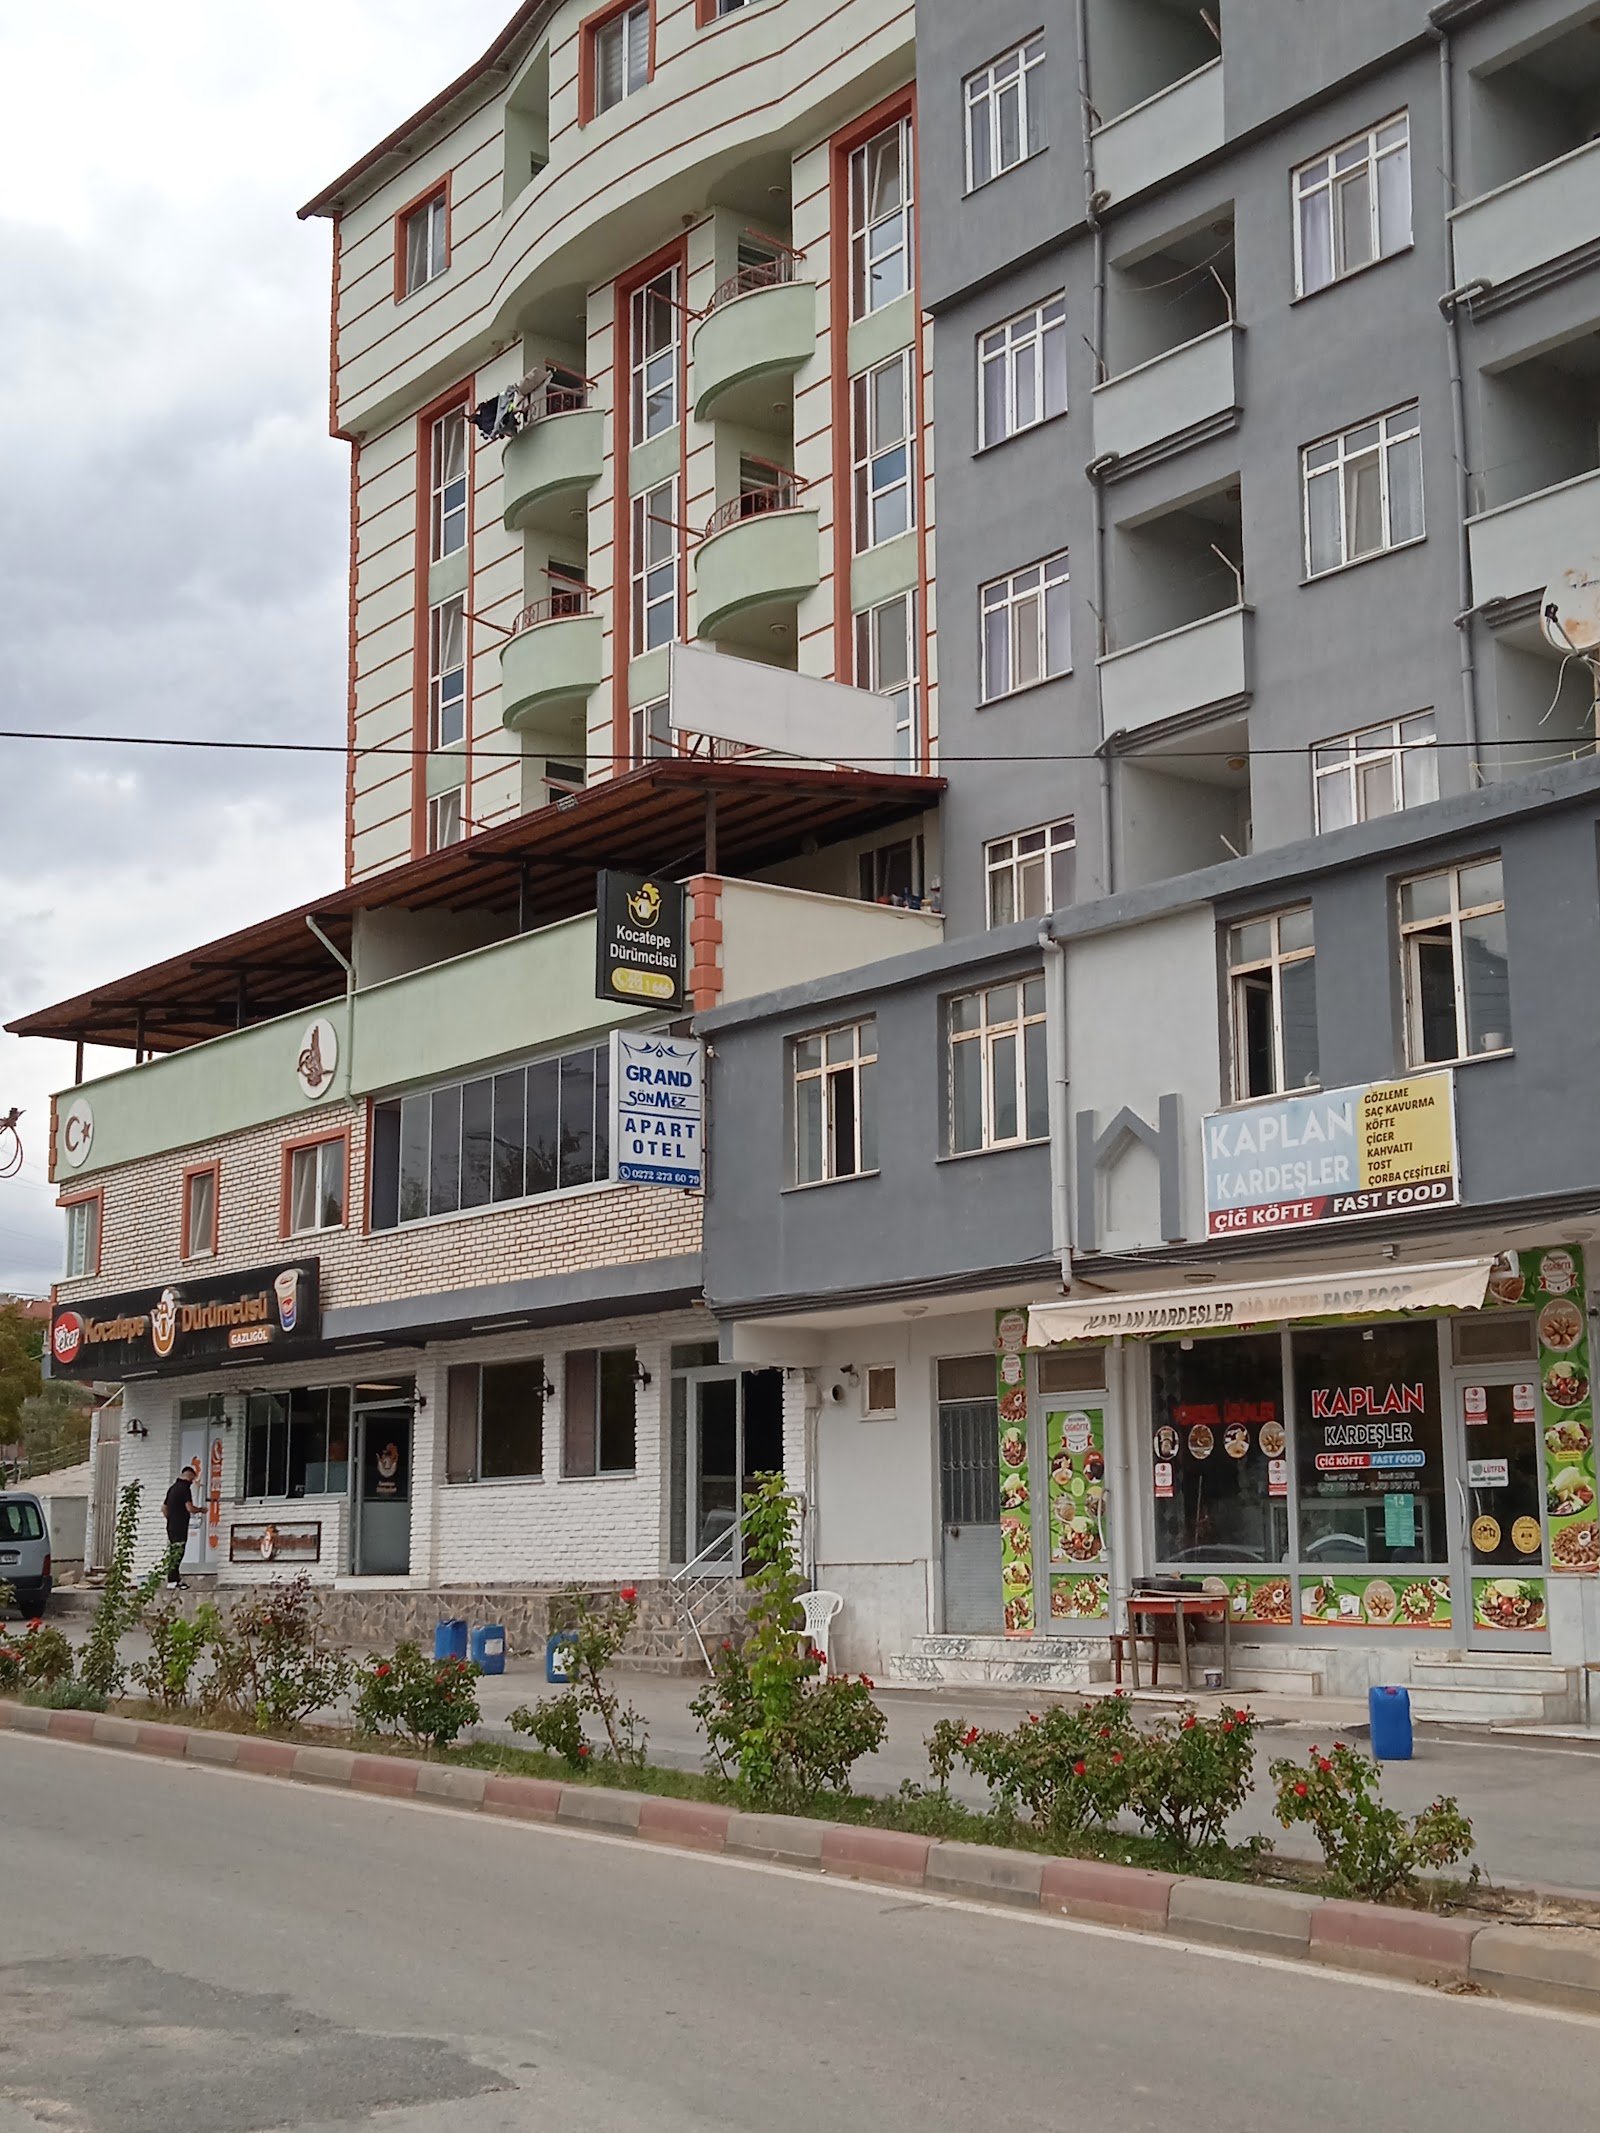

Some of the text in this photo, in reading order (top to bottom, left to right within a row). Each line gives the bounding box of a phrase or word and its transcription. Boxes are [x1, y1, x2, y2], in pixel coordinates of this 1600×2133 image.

[616, 924, 671, 950] Kocatepe
[610, 943, 677, 968] Dürümcüsü
[626, 1064, 692, 1088] GRAND
[1364, 1087, 1409, 1104] GÖZLEME
[1365, 1096, 1435, 1118] SAÇ KAVURMA
[625, 1118, 695, 1138] APART
[1210, 1101, 1354, 1160] KAPLAN
[1365, 1117, 1395, 1131] KÖFTE
[633, 1139, 686, 1158] OTEL
[1367, 1142, 1413, 1158] KAHVALTI
[631, 1169, 654, 1180] 0272
[656, 1171, 673, 1181] 273
[1216, 1154, 1350, 1200] KARDEŞLER
[1368, 1159, 1392, 1171] TOST
[1368, 1160, 1450, 1187] ÇORBA ÇEŞİTLERİ
[1333, 1182, 1447, 1213] FAST FOOD
[1214, 1202, 1313, 1232] ÇİĞ KÖFTE
[84, 1314, 146, 1344] Kocatepe
[1312, 1382, 1425, 1418] KAPLAN
[1324, 1422, 1414, 1448] KARDEŞLER
[1336, 1456, 1365, 1466] KÖFTE
[1371, 1455, 1395, 1464] FAST
[1395, 1454, 1421, 1464] FOOD
[1483, 1463, 1506, 1473] LÜTFEN
